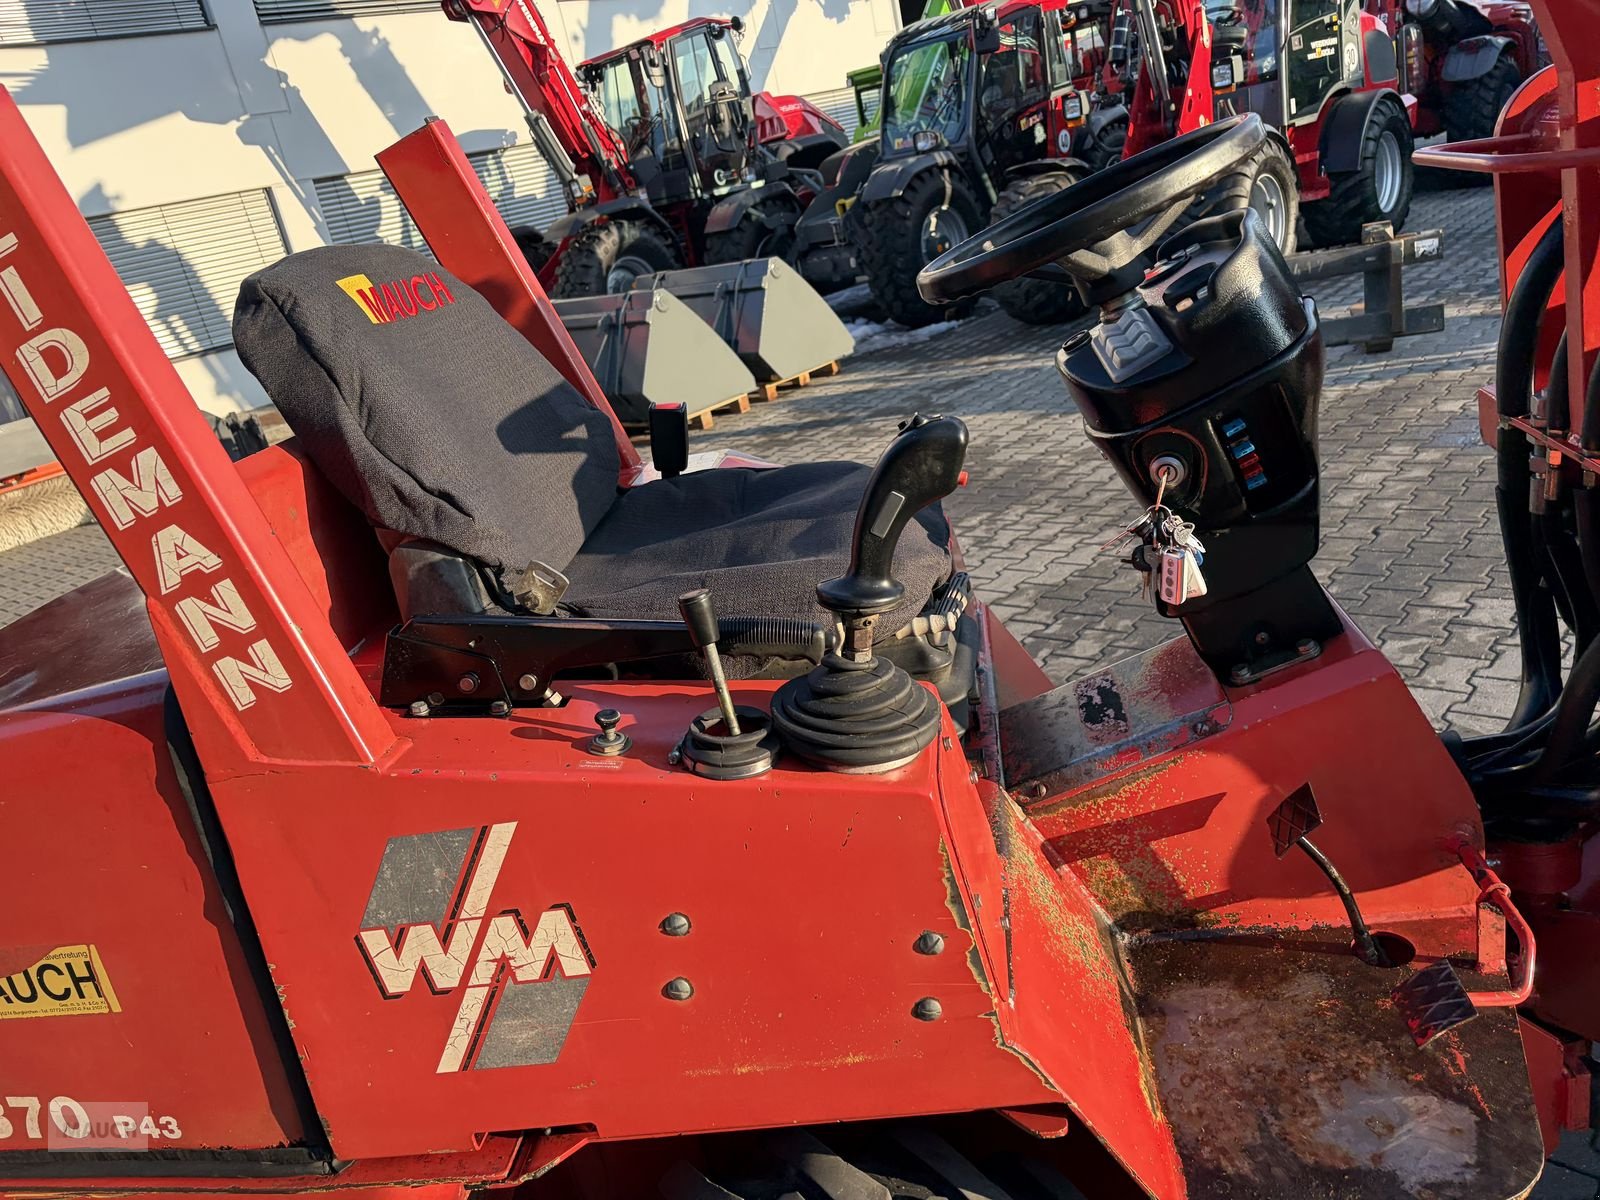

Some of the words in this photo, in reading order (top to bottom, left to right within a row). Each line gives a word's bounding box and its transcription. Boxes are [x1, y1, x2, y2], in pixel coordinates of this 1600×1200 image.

[1346, 48, 1356, 65] 30
[355, 272, 455, 324] MAUCH
[44, 950, 89, 960] alvertretung
[113, 1116, 182, 1139] P43
